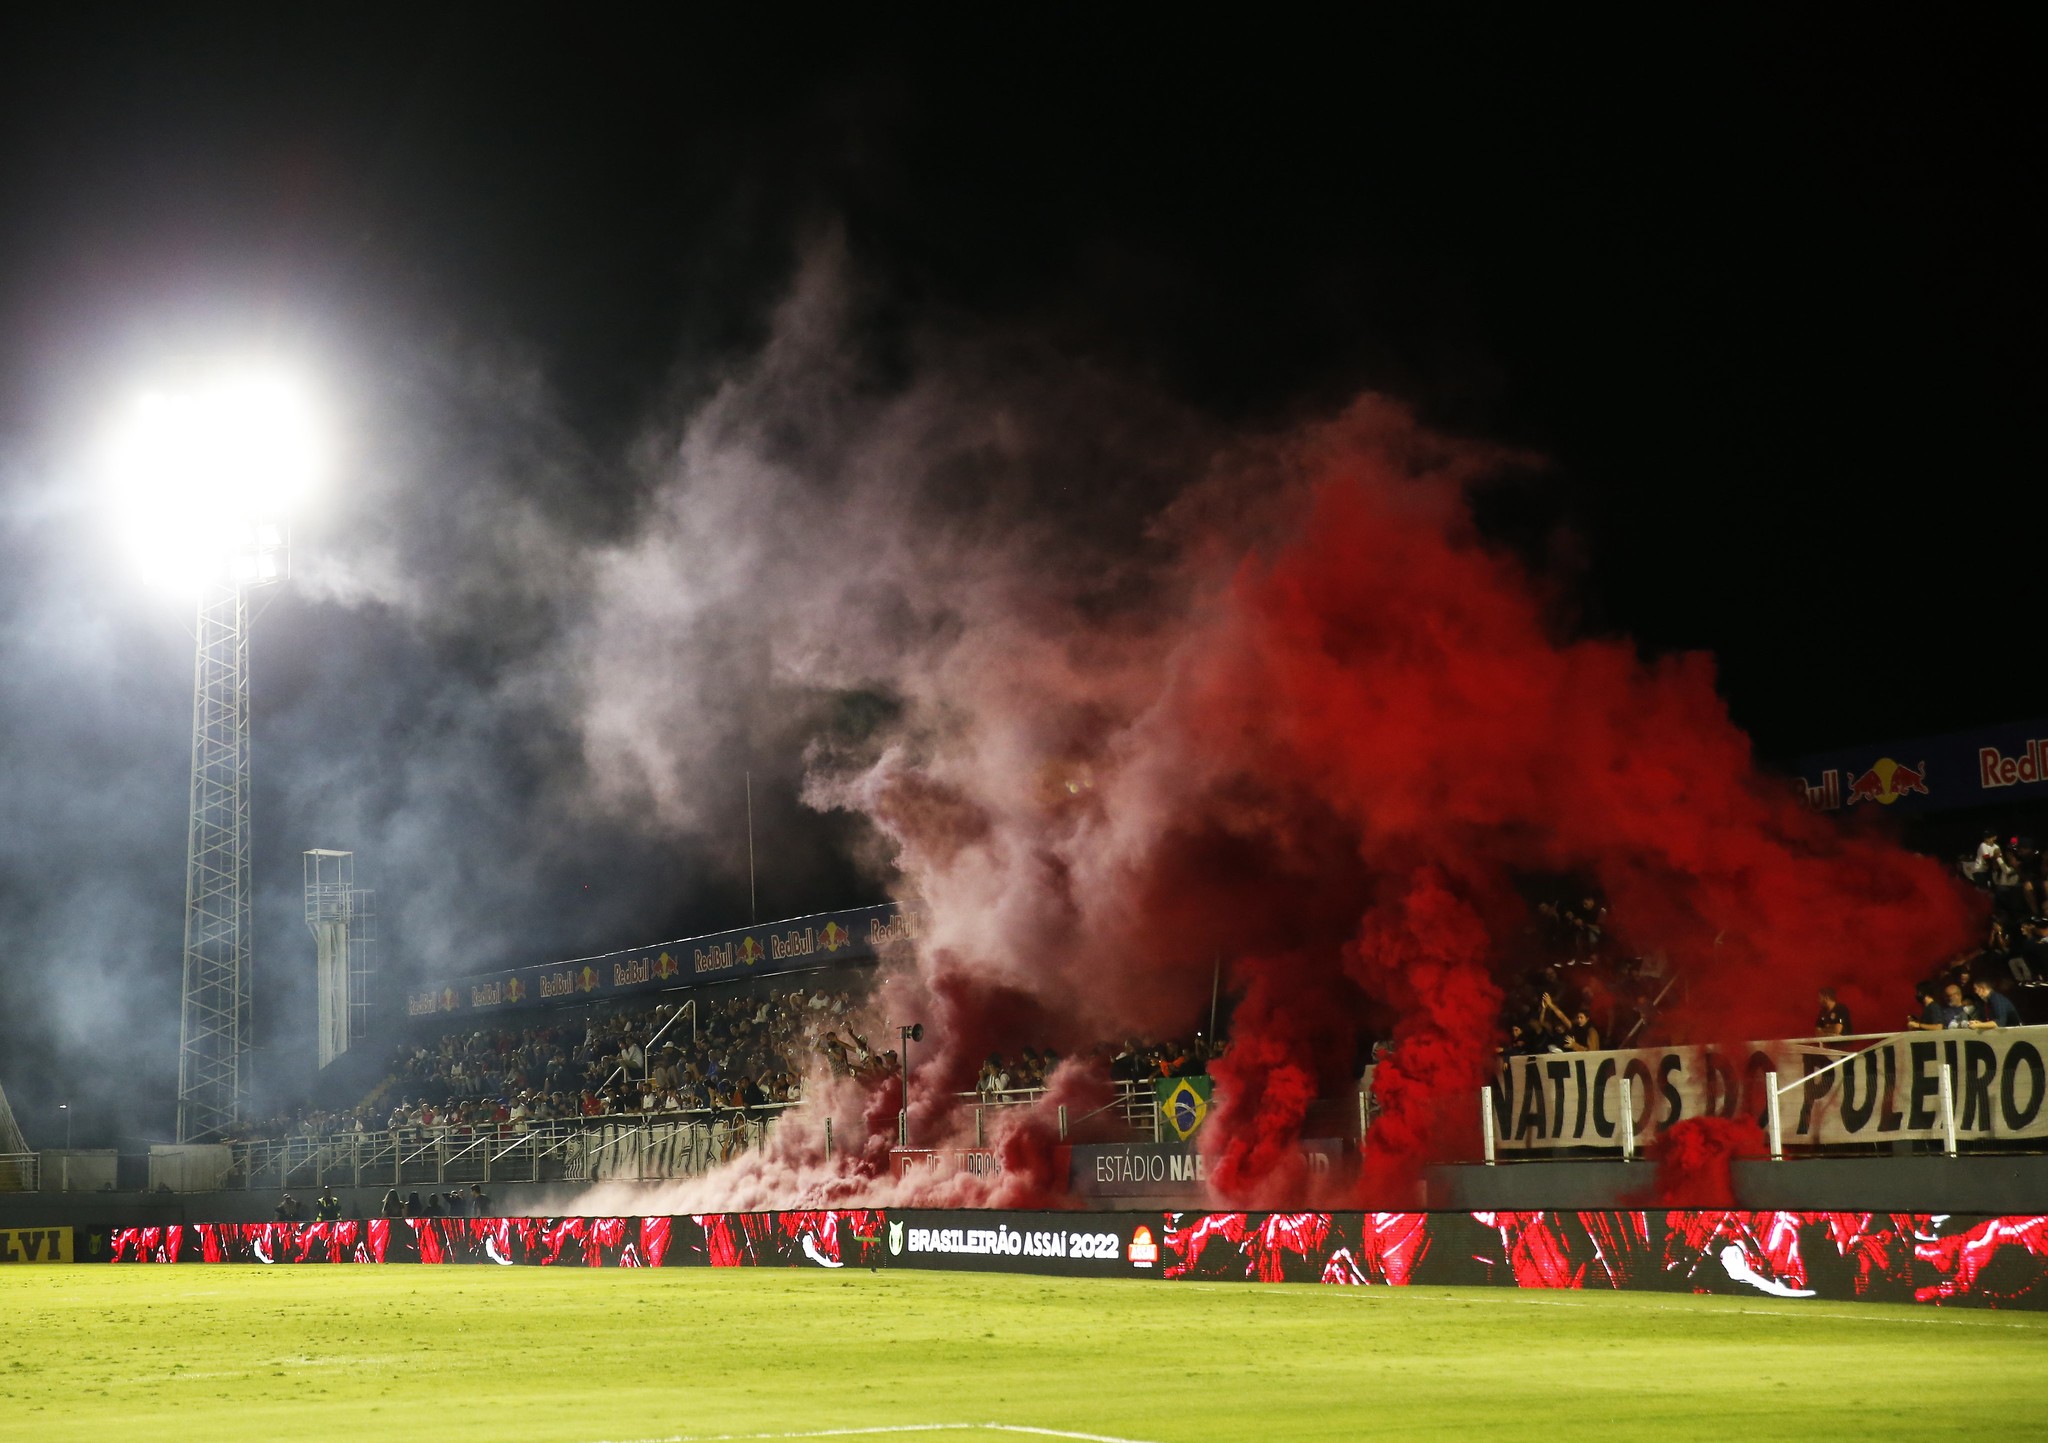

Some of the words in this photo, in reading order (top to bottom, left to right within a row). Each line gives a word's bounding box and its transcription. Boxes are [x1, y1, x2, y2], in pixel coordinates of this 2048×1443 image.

[1491, 1054, 1682, 1141] NÁTICOS
[1796, 1039, 2046, 1135] PULEIRO
[1096, 1147, 1165, 1182] ESTÁDIO
[1170, 1154, 1206, 1181] NAB
[908, 1224, 1022, 1255] BRASILEIRÃO
[1024, 1230, 1067, 1257] ASSAÍ
[1069, 1233, 1120, 1259] 2022
